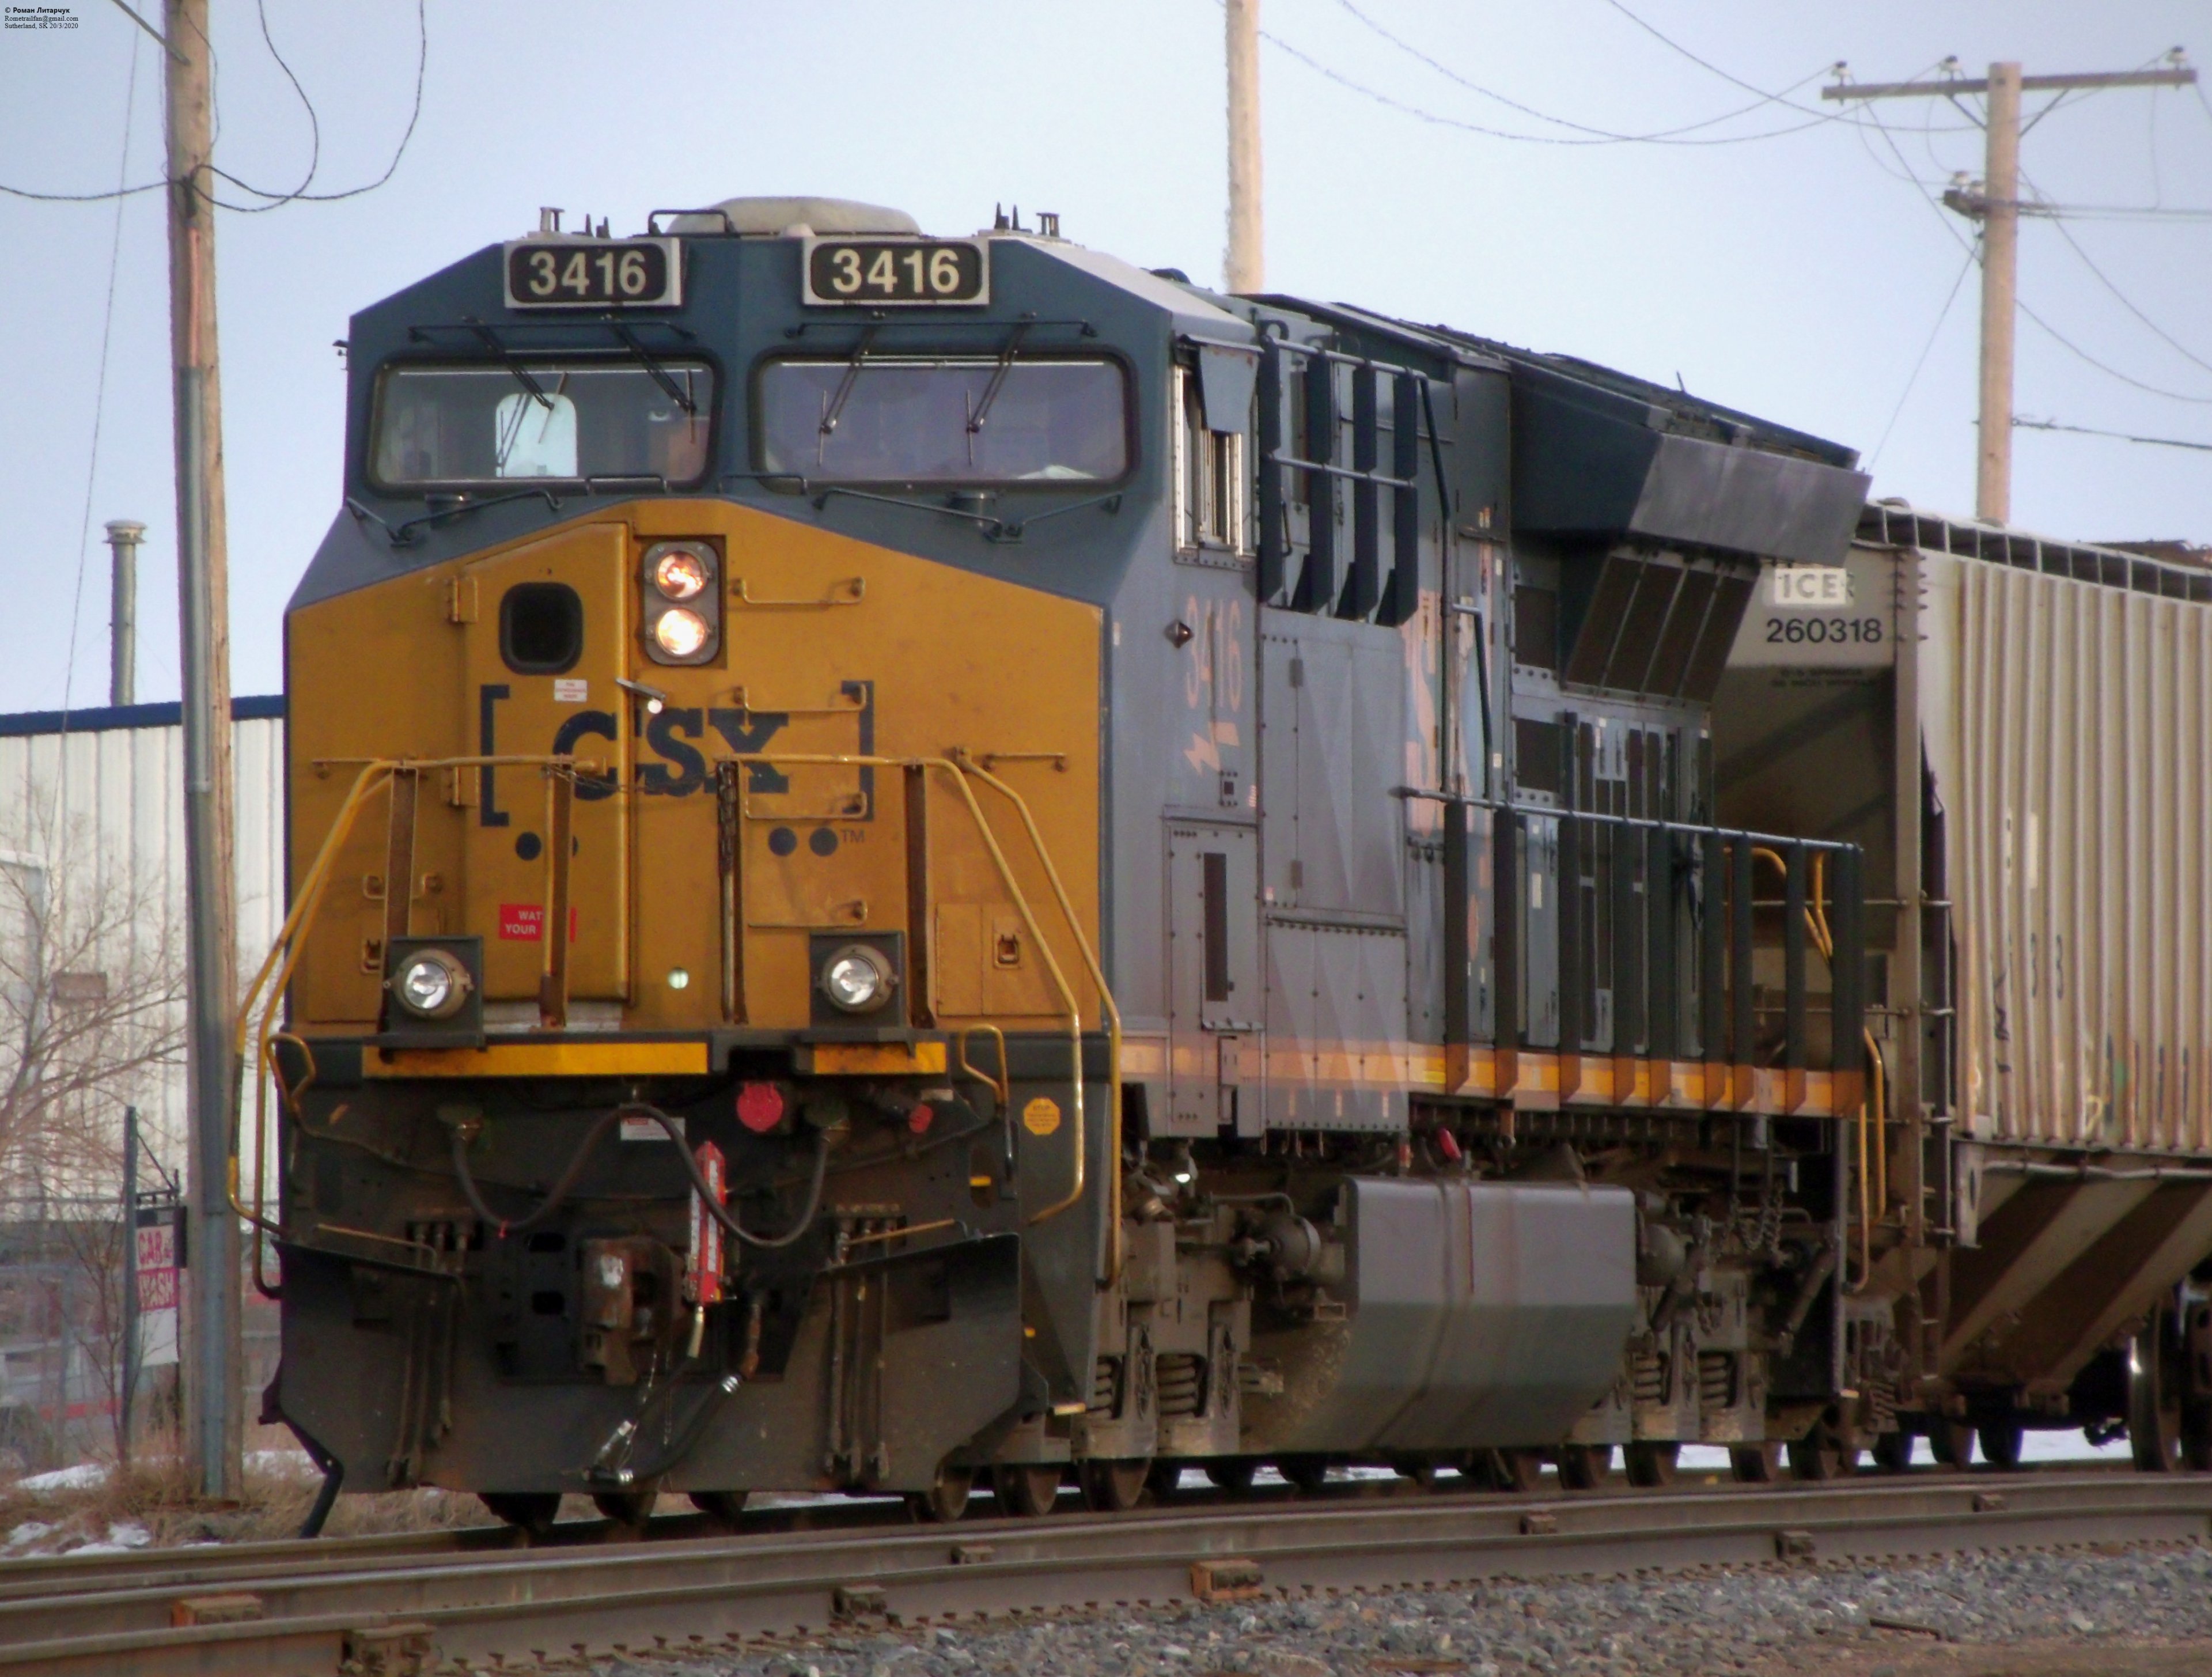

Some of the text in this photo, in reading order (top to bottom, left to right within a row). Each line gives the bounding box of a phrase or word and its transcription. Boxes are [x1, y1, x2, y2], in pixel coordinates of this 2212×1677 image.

[529, 249, 646, 296] 3416
[832, 248, 960, 293] 3416
[1766, 618, 1883, 643] 260318
[552, 707, 789, 801] CSX
[505, 923, 537, 935] YOUR
[518, 910, 545, 921] WAT
